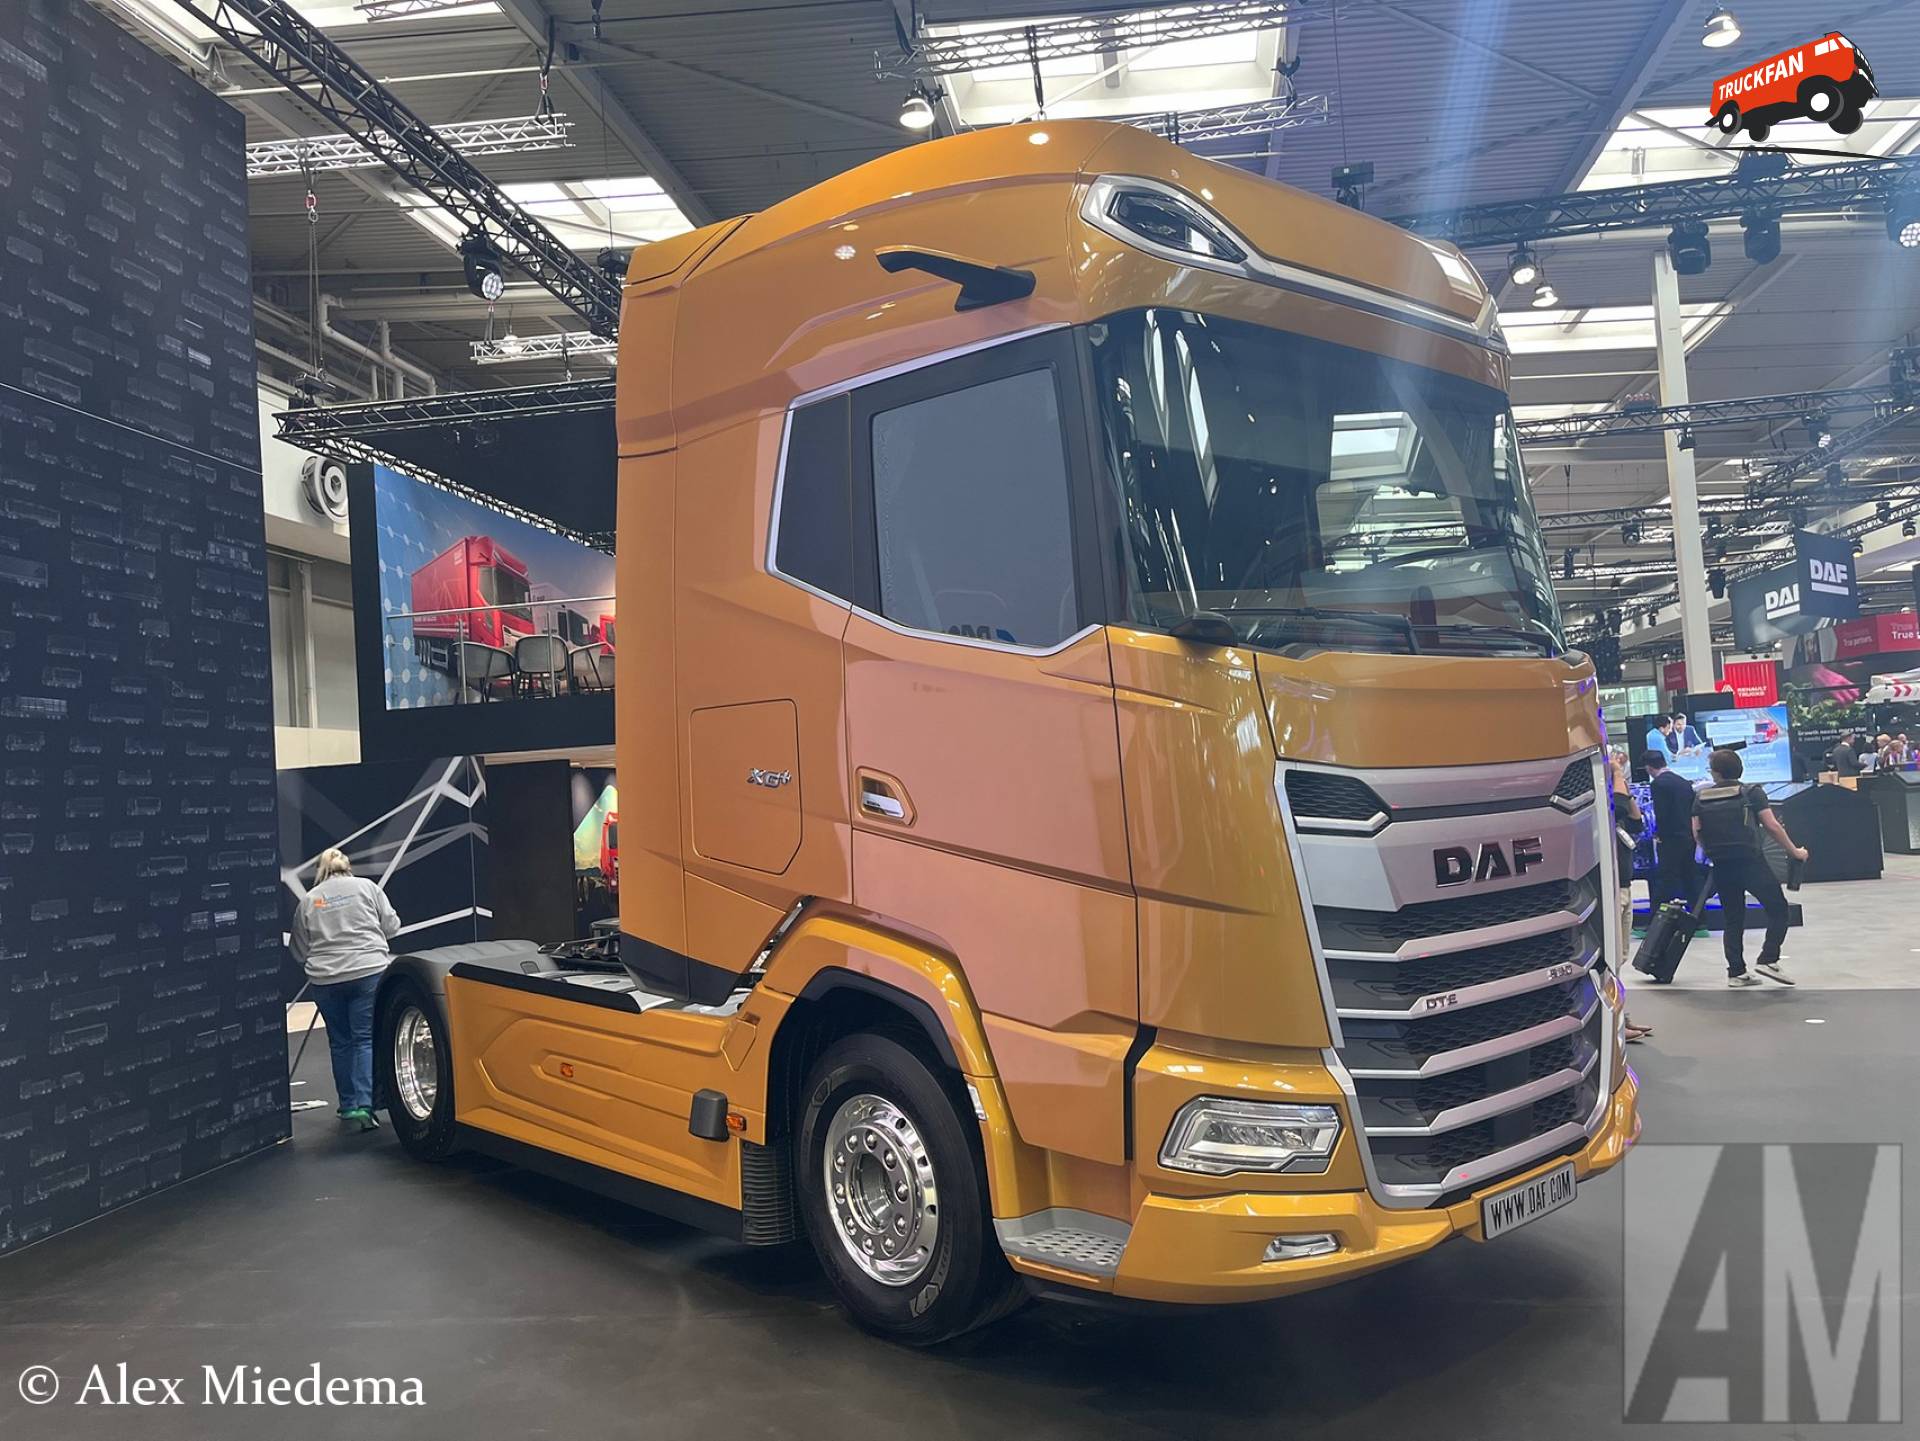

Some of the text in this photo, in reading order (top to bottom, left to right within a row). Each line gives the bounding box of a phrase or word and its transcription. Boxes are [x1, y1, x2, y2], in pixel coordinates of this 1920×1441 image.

[1809, 558, 1848, 584] DAF
[1433, 836, 1544, 889] DAF
[1490, 1169, 1572, 1232] WWW.DAF.COM
